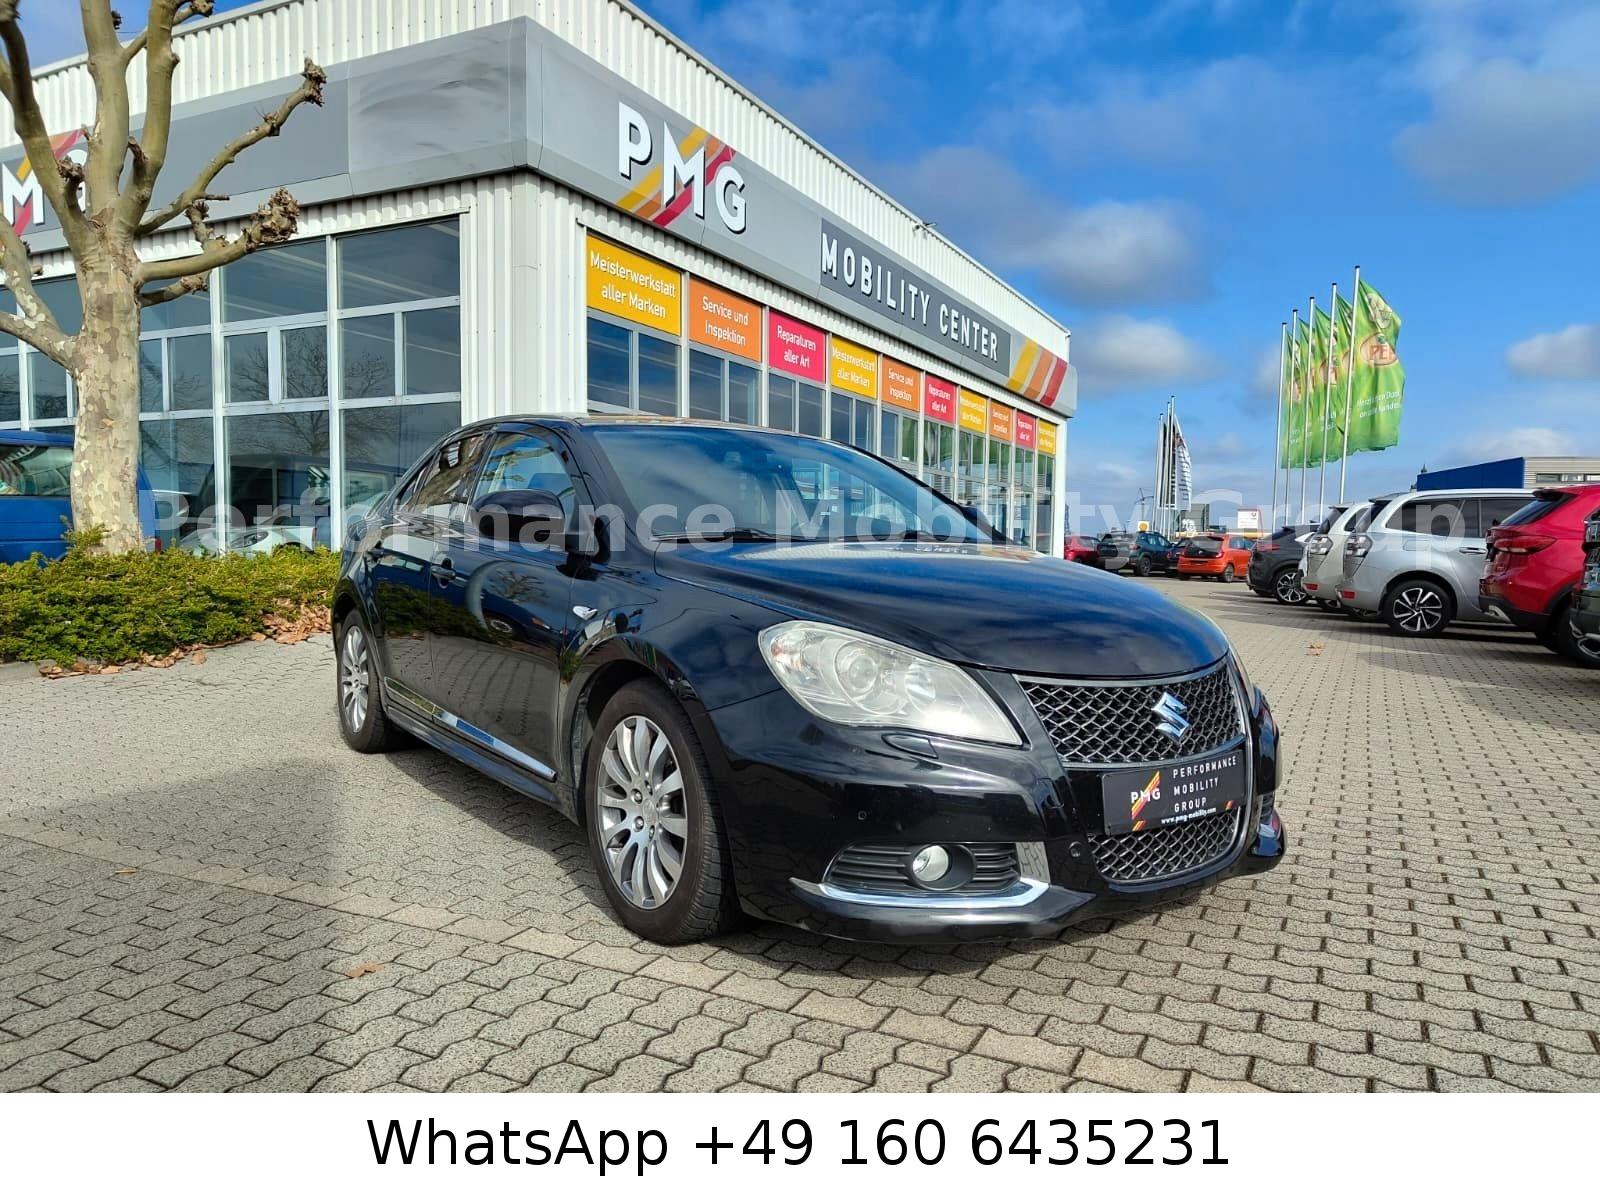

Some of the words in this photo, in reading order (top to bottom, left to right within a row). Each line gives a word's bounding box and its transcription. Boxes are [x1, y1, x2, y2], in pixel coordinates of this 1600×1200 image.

[618, 101, 747, 234] PMG
[590, 250, 677, 298] Meisterwerkstatt
[601, 284, 627, 304] aller
[629, 291, 666, 318] Marken
[821, 232, 930, 326] MOBILITY
[939, 303, 999, 362] CENTER
[702, 296, 732, 320] Service
[734, 310, 748, 326] und
[705, 320, 746, 346] Inspektion
[777, 325, 816, 352] Reparaturen
[783, 349, 799, 364] aller
[800, 354, 810, 368] Art
[1173, 755, 1236, 779] PERFORMANCE
[1130, 787, 1161, 804] PMG
[1173, 777, 1219, 796] MOBILITY
[1174, 797, 1207, 813] GROUP
